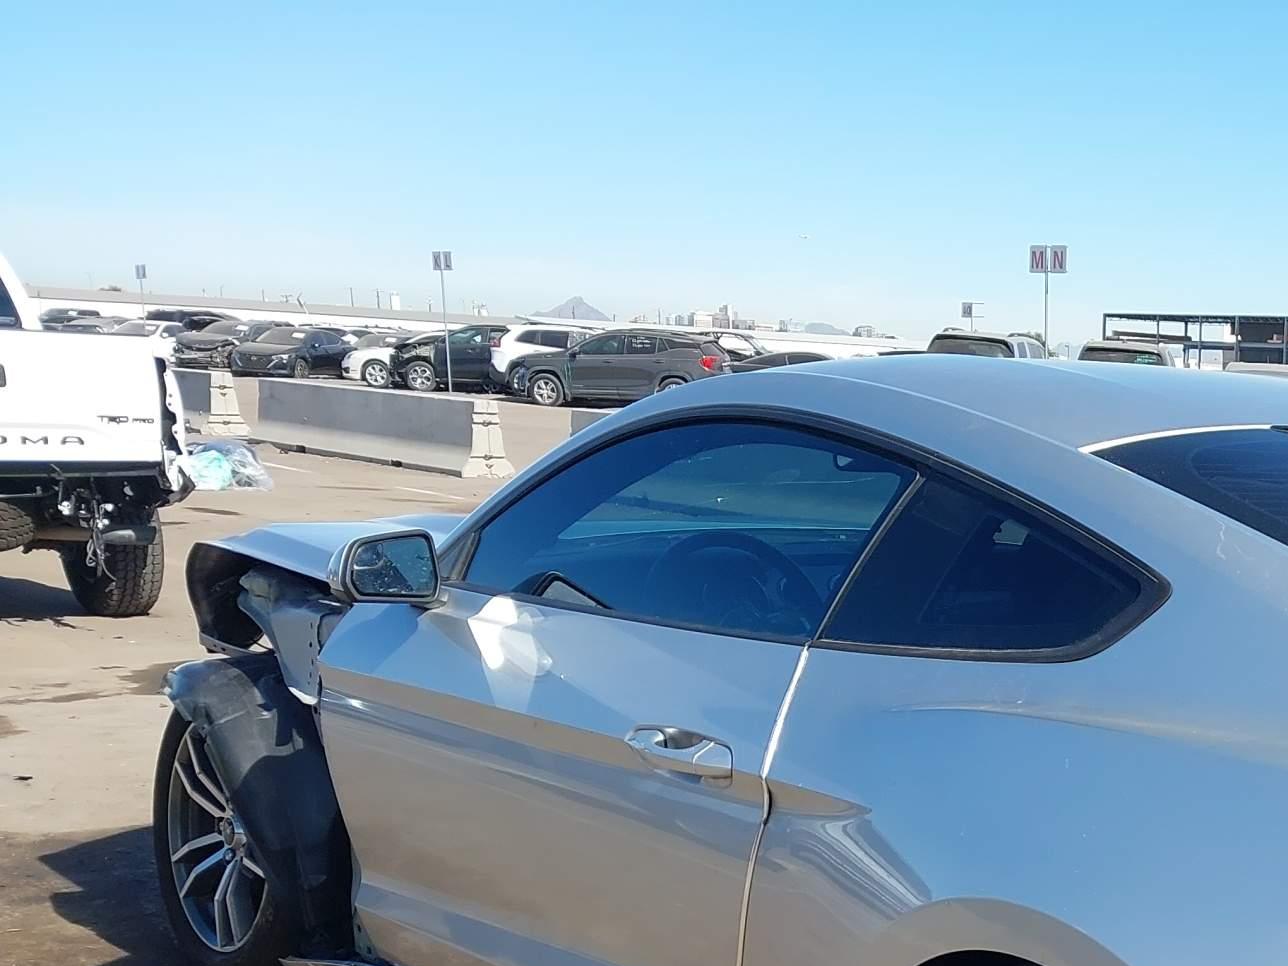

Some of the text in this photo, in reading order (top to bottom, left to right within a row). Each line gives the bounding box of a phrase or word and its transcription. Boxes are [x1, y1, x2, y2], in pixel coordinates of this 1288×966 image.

[1031, 250, 1064, 269] M N
[97, 415, 129, 424] TRD
